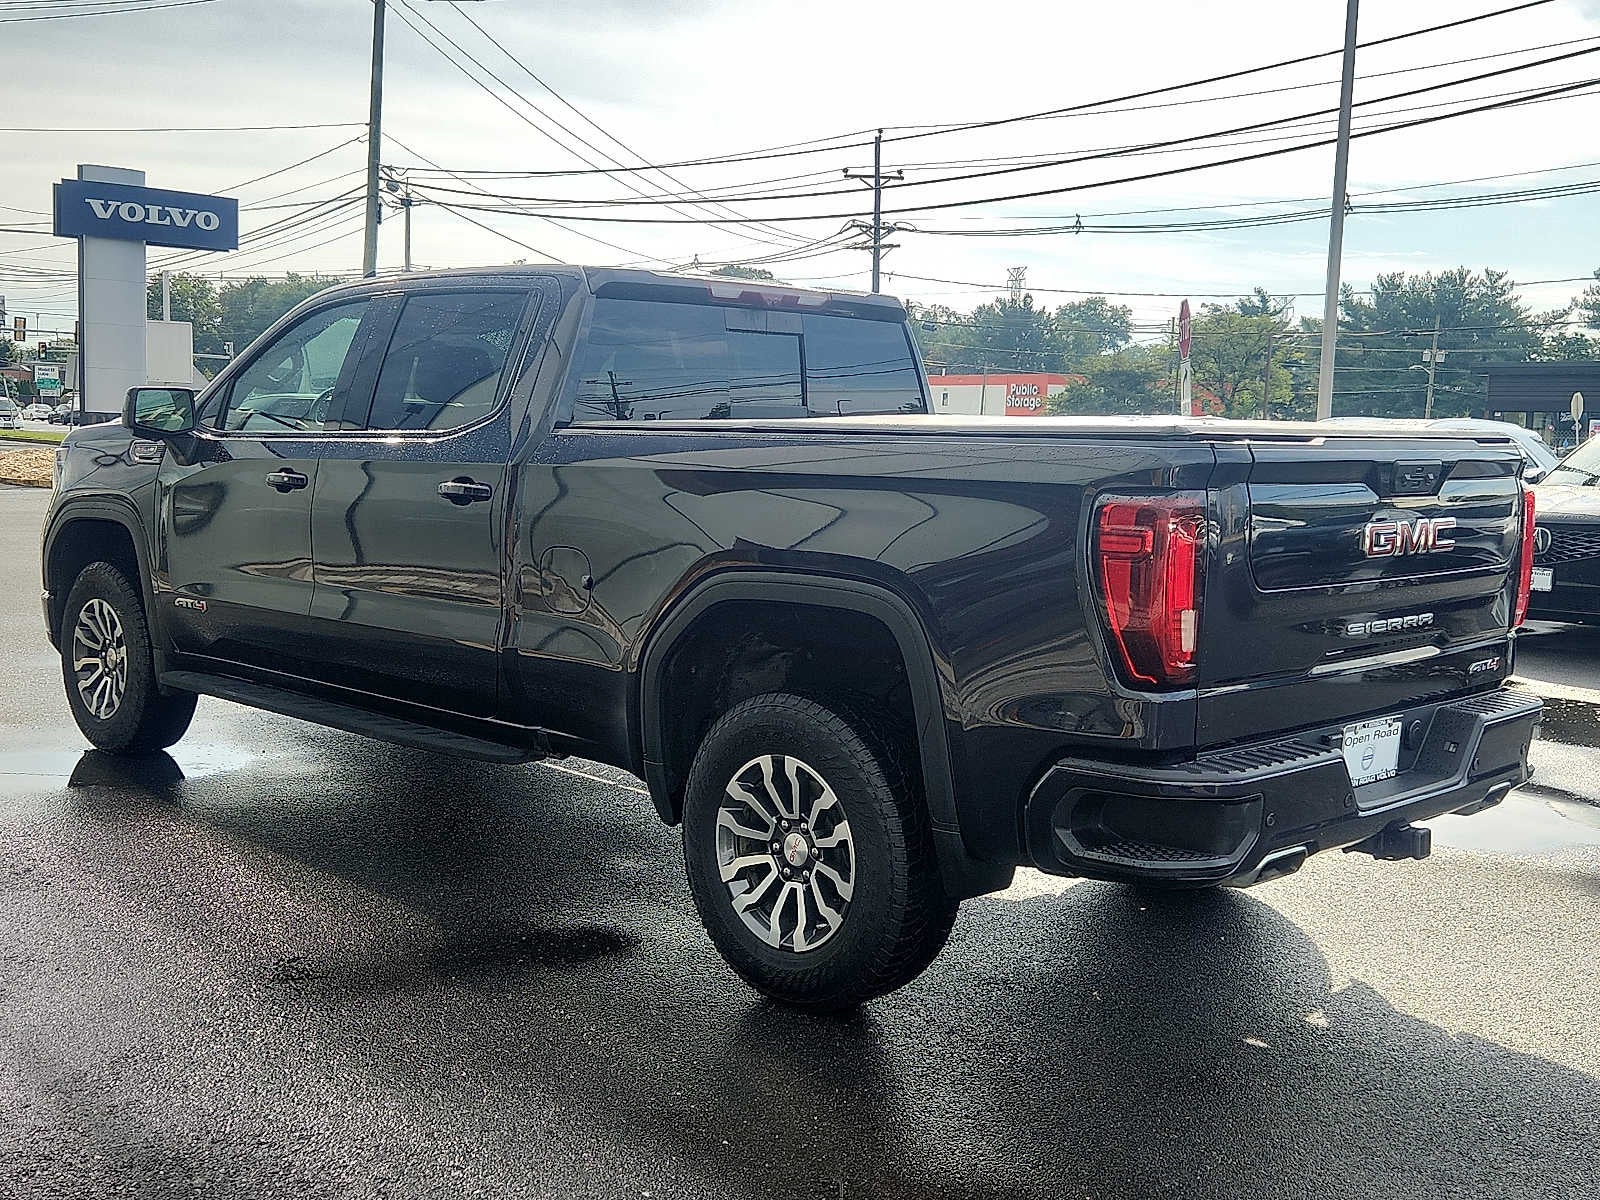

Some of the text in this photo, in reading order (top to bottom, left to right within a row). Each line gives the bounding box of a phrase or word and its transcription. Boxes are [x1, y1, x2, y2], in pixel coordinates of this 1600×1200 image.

[84, 198, 220, 231] VOLVO
[1011, 384, 1039, 395] Public
[1006, 395, 1042, 410] Storage
[1365, 516, 1457, 558] GMC
[174, 597, 208, 613] AT4
[1347, 612, 1434, 636] SIERRA
[1469, 656, 1500, 674] AT4
[1344, 726, 1399, 747] Open Road
